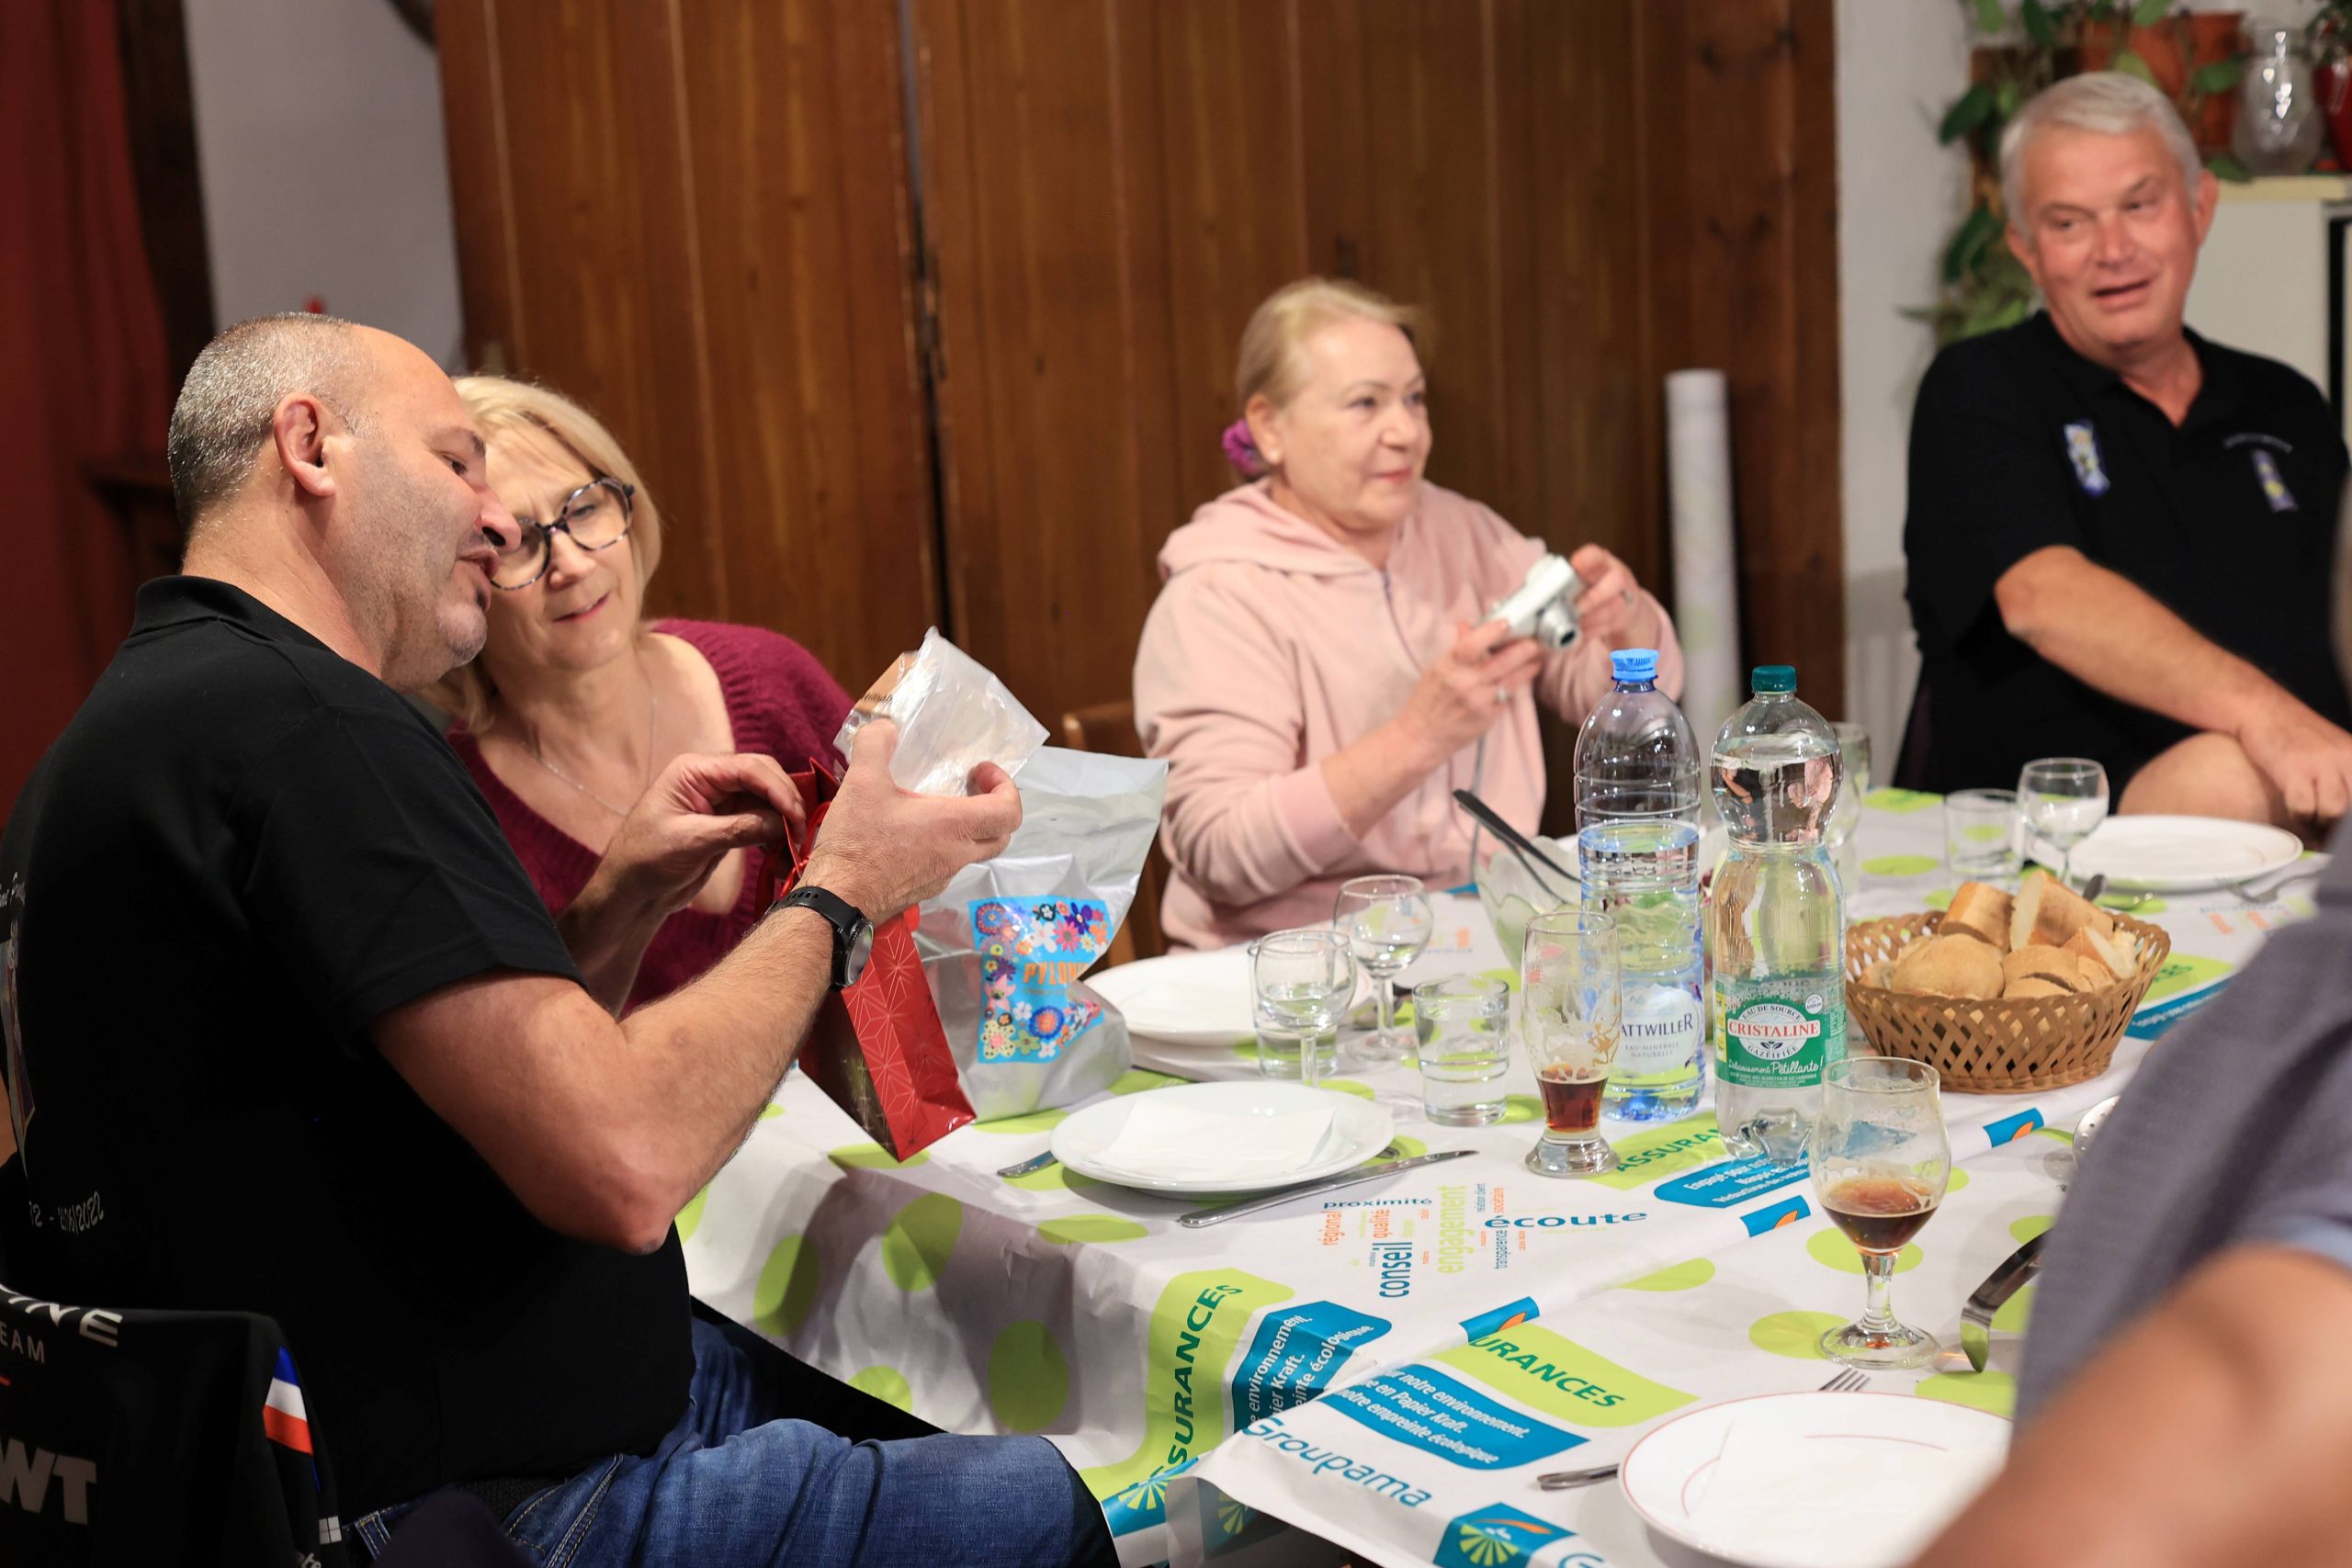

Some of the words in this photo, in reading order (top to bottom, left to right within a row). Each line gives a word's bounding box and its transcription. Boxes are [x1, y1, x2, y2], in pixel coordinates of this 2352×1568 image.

[1023, 961, 1089, 985] PYLON
[1742, 1007, 1757, 1020] EAU
[1758, 1004, 1769, 1012] DE
[1770, 1004, 1802, 1021] SOURCE
[1728, 1021, 1819, 1037] CRISTALINE
[1323, 1198, 1432, 1209] proximité
[1317, 1210, 1345, 1246] régional
[1368, 1209, 1394, 1238] qualité
[1436, 1185, 1476, 1274] engagement
[1485, 1212, 1647, 1228] écoute
[1494, 1230, 1511, 1269] transparence
[1372, 1242, 1412, 1298] conseil
[1310, 1325, 1374, 1372] écologique
[1271, 1354, 1306, 1390] Kraft.
[1398, 1371, 1436, 1395] notre
[1392, 1391, 1437, 1416] Papier
[1366, 1404, 1431, 1438] empreinte
[1241, 1416, 1432, 1508] Groupama
